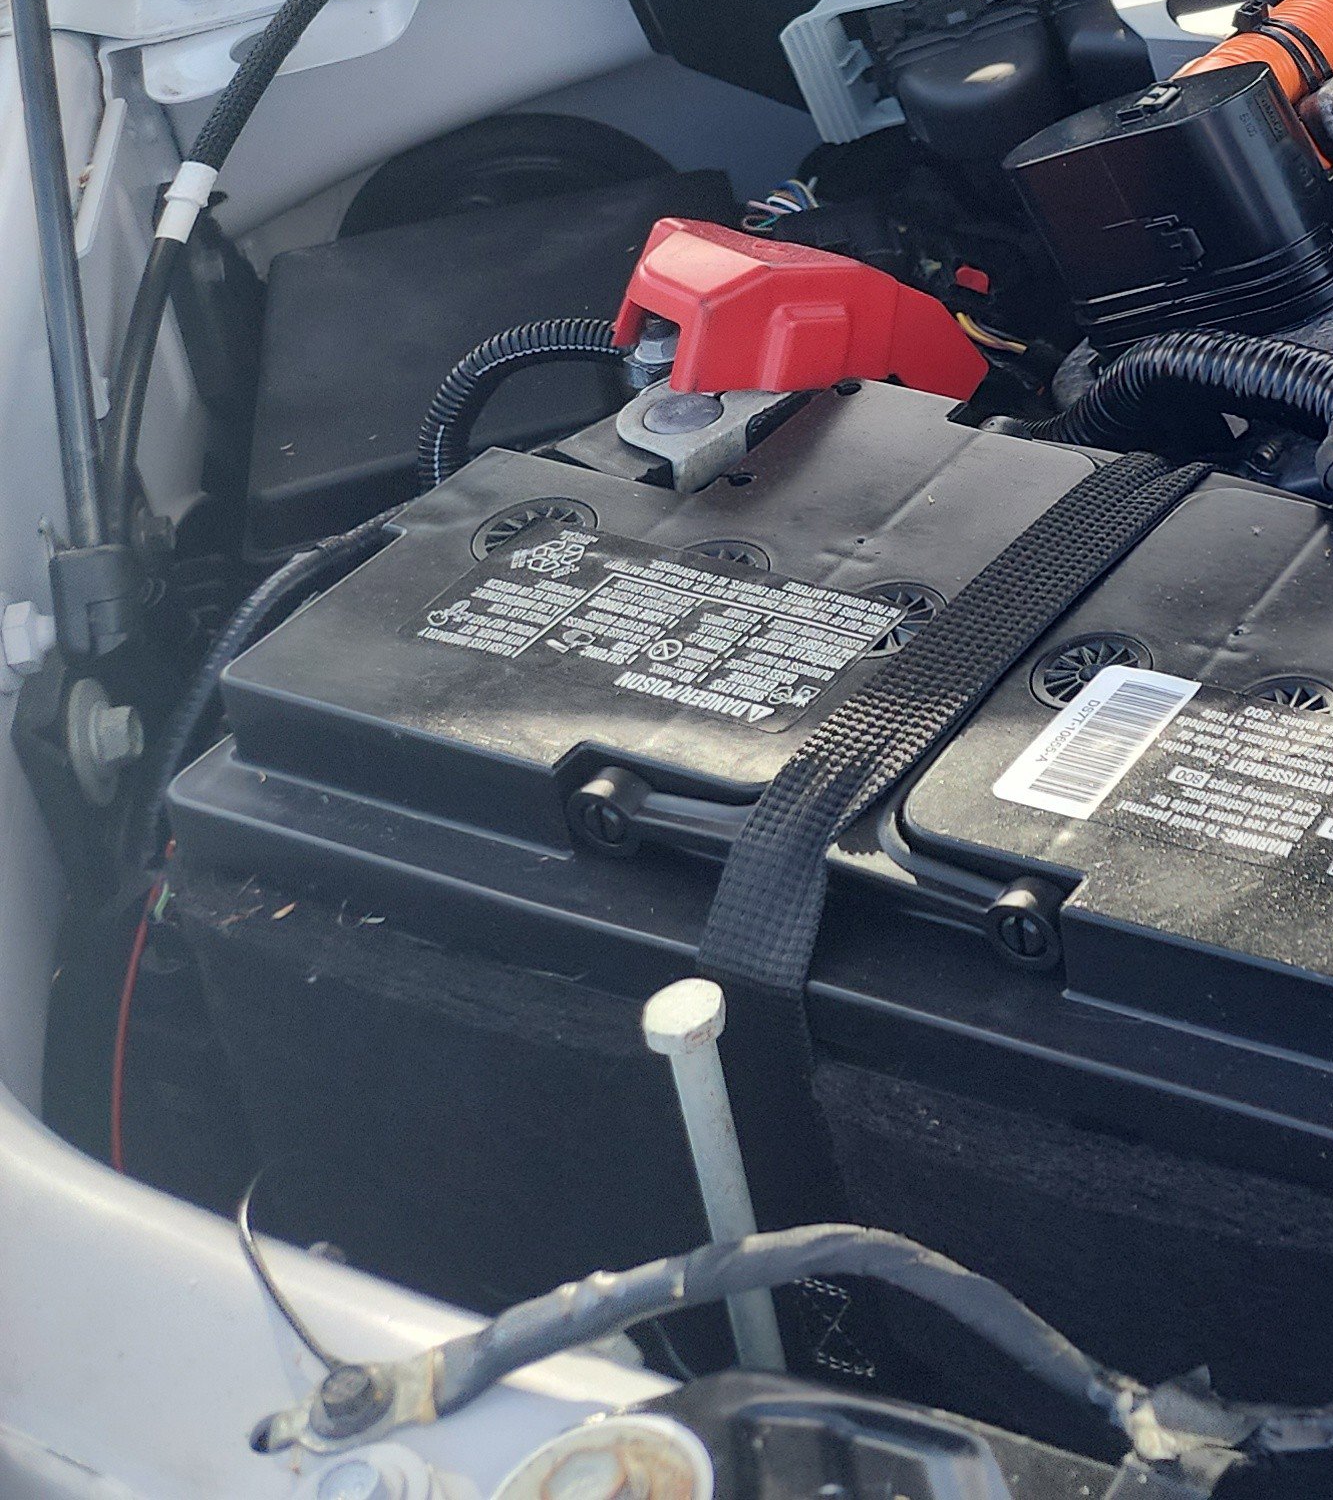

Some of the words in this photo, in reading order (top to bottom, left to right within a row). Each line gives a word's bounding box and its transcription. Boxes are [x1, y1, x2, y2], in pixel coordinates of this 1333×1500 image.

[615, 672, 750, 716] DANGER/POISON
[1243, 706, 1272, 721] 800
[1175, 770, 1204, 784] 800
